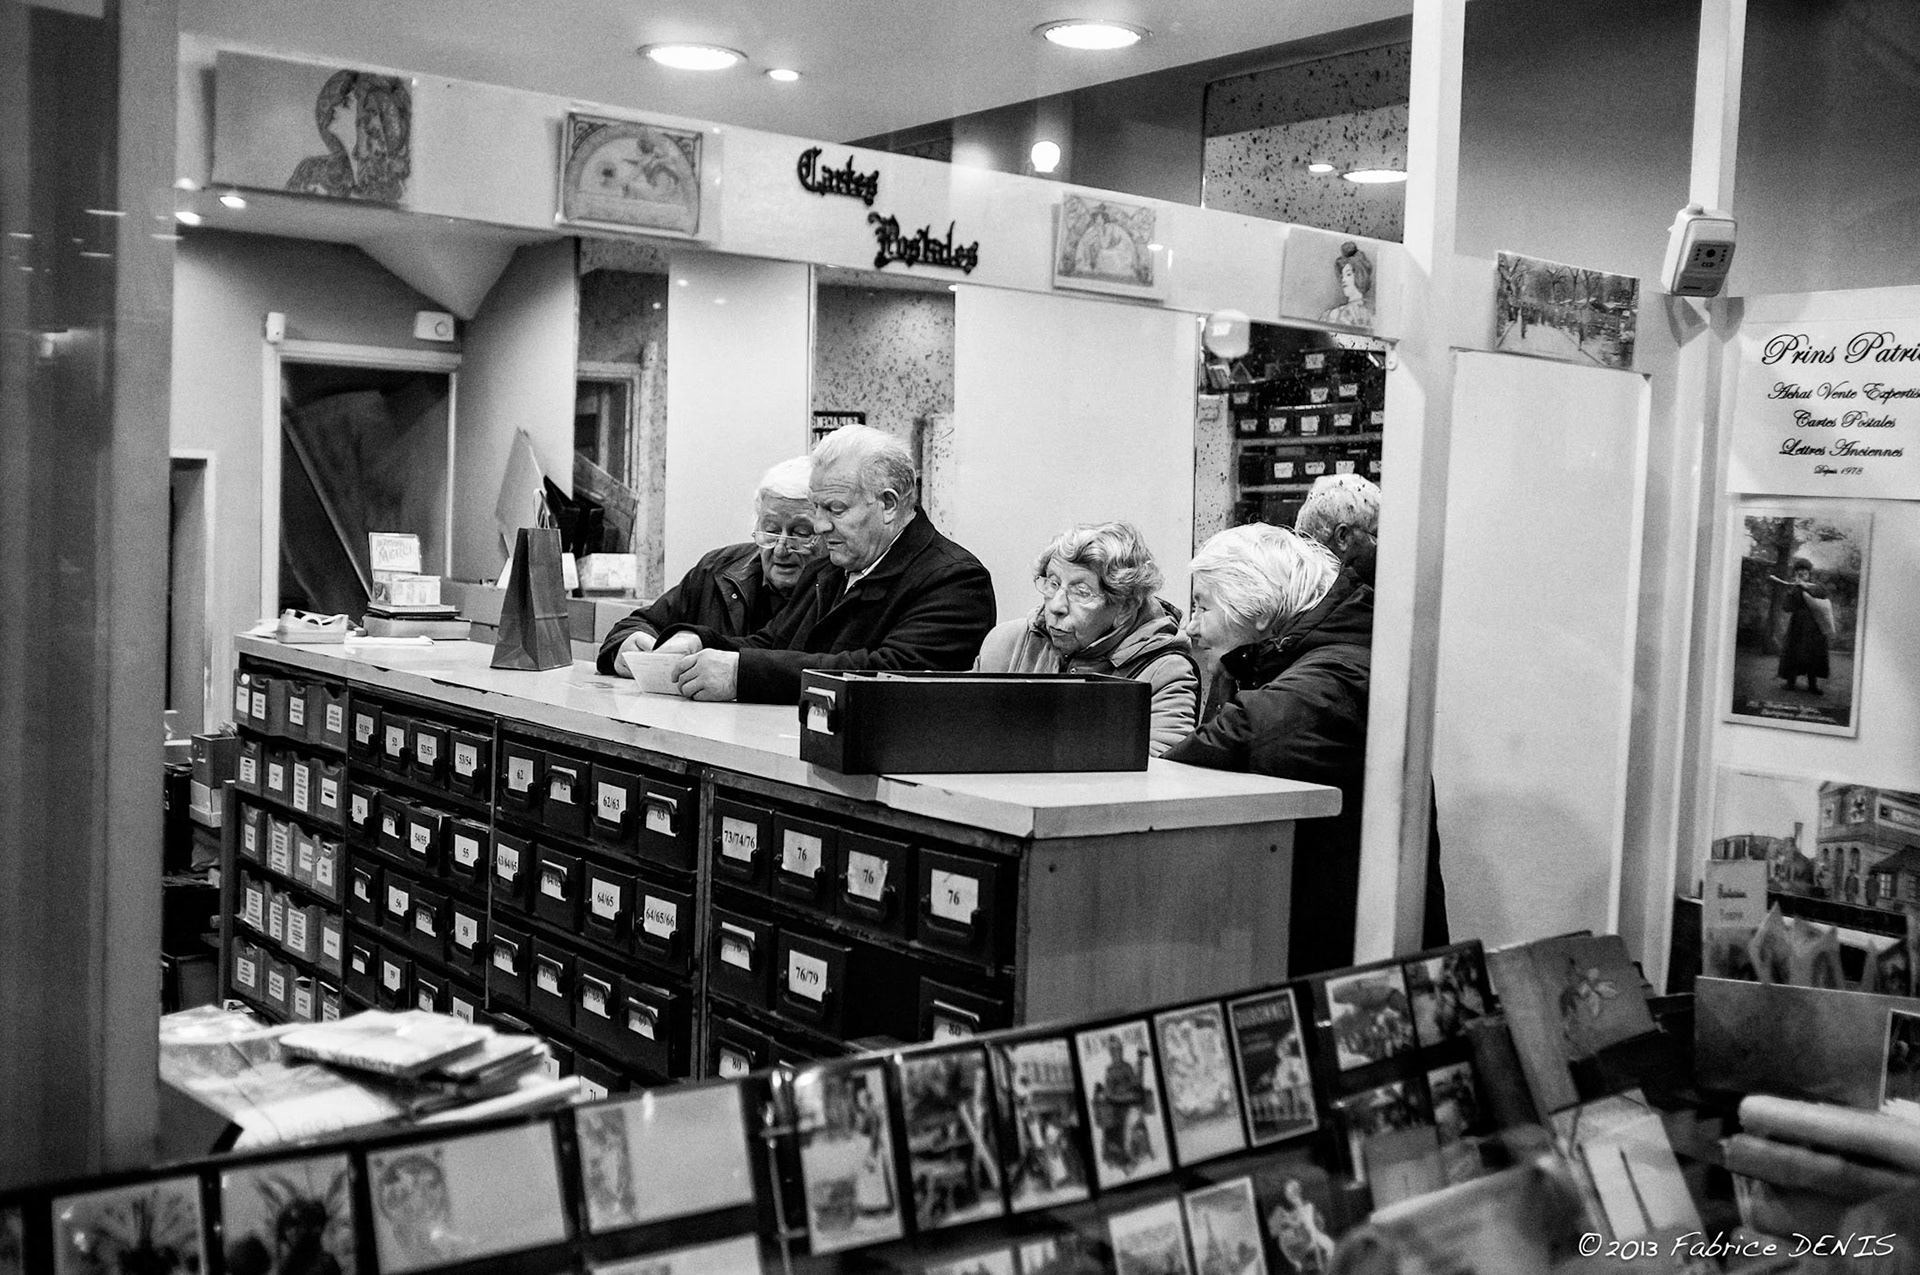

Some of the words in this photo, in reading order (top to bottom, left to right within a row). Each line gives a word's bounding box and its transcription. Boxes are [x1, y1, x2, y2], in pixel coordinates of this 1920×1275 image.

[797, 146, 880, 207] Cartes
[867, 211, 979, 275] Postales
[1762, 334, 1837, 365] Prins
[1767, 381, 1813, 400] Achat
[1817, 380, 1858, 401] Vente
[1793, 409, 1837, 428] Cartes
[1841, 410, 1897, 428] Postales
[1779, 437, 1827, 456] Lettres
[1829, 438, 1903, 457] Anciennes
[1840, 466, 1864, 476] 1978
[516, 769, 524, 780] 62
[603, 796, 620, 810] 62/63
[724, 830, 755, 849] 73/74/76
[797, 846, 807, 861] 76
[863, 868, 874, 885] 76
[597, 892, 614, 907] 64/65
[947, 889, 960, 906] 76
[645, 907, 675, 928] 64/65/66
[795, 966, 819, 985] 76/79
[732, 1057, 741, 1071] 80
